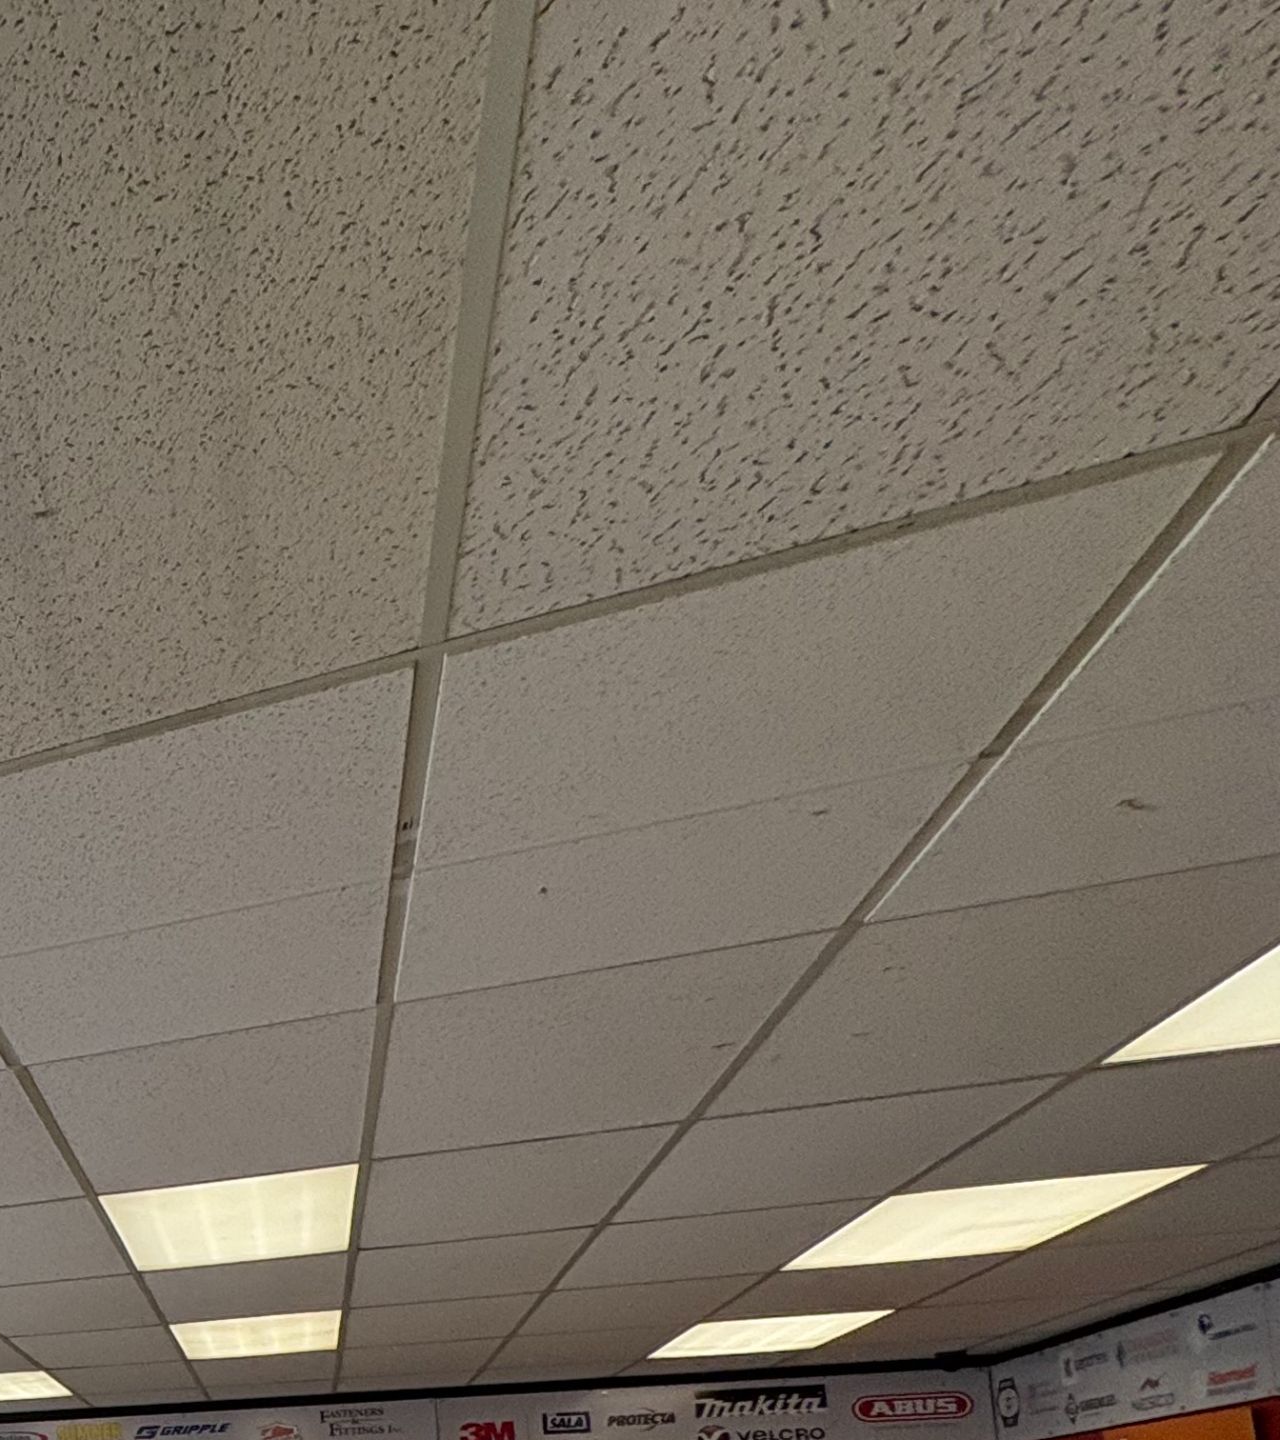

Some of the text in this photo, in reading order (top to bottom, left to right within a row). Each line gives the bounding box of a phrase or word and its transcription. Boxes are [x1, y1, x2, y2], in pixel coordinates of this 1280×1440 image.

[871, 1398, 957, 1416] ABUS
[160, 1422, 231, 1437] GRIPPLE
[550, 1416, 584, 1429] SALA
